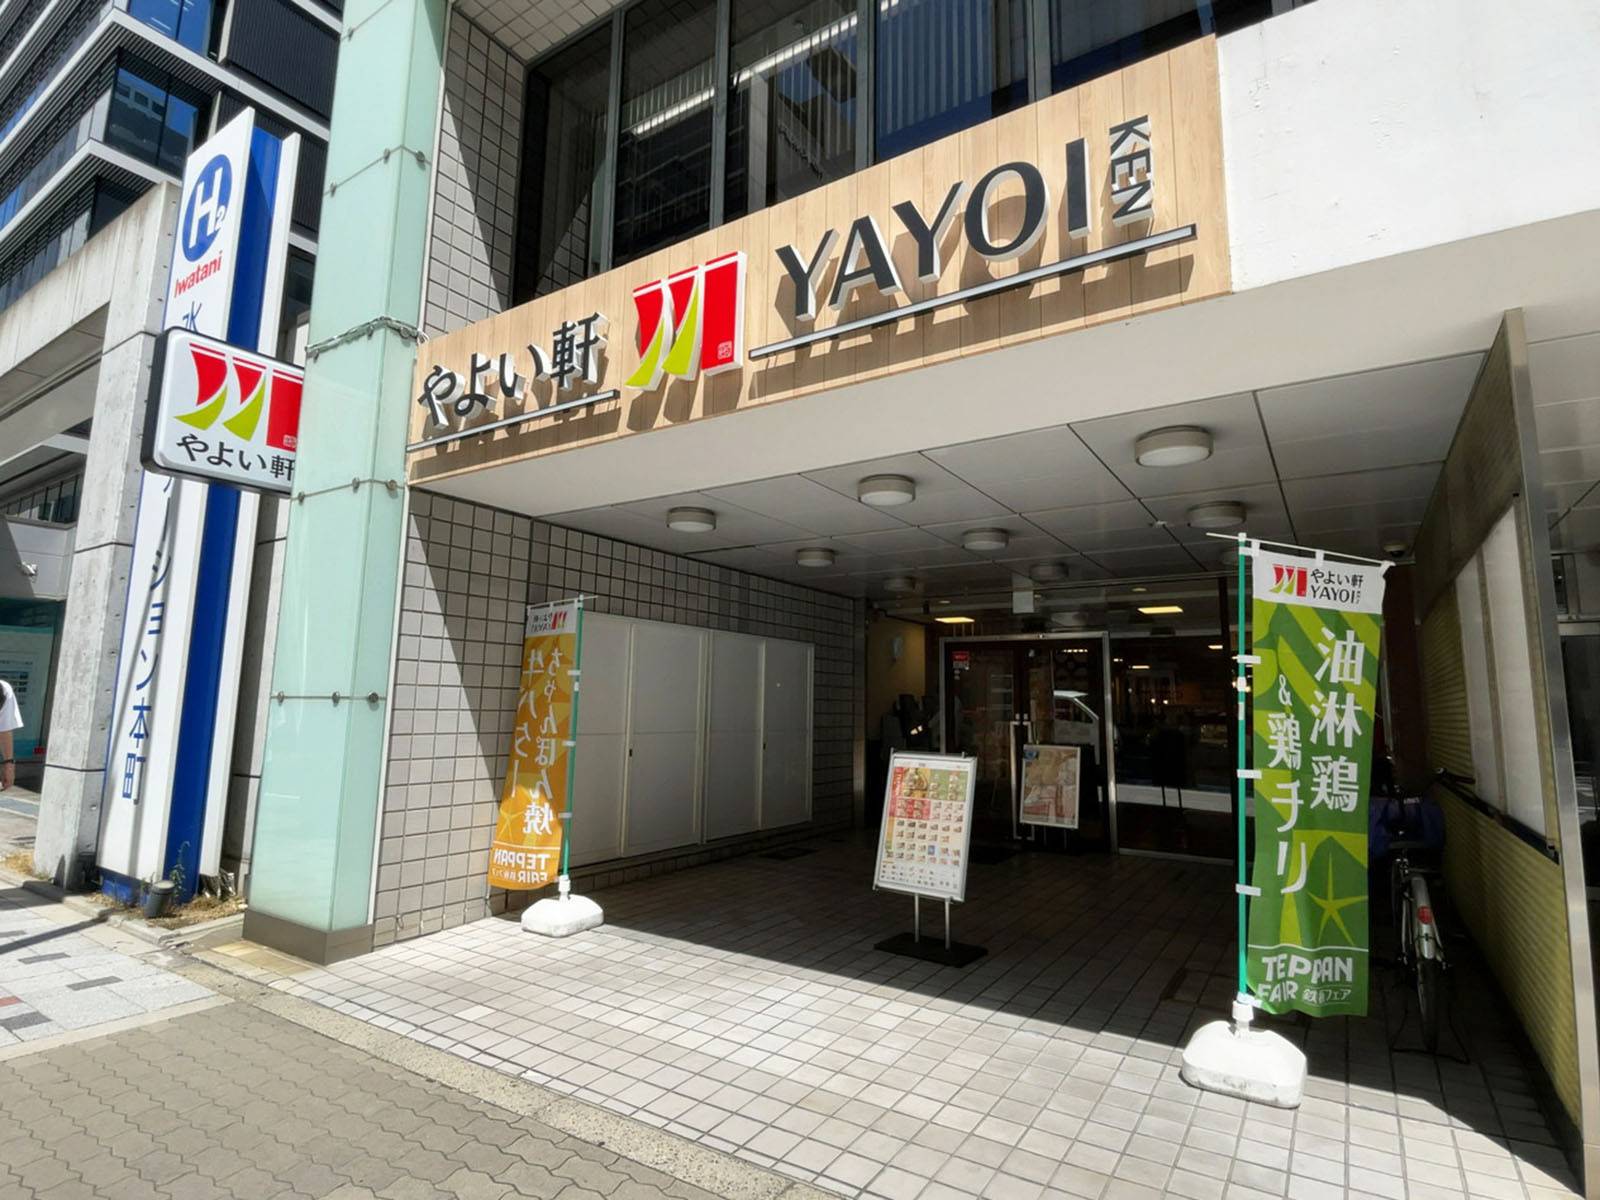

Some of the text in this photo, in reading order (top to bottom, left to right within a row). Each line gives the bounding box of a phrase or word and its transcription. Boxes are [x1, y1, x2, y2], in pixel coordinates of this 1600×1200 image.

[1109, 115, 1154, 227] KEN
[775, 136, 1092, 321] YAYOI
[174, 250, 223, 299] Iwatani
[417, 311, 607, 430] やよい軒
[176, 433, 296, 482] やよい軒
[1310, 568, 1364, 589] やよい軒
[1310, 585, 1356, 604] YAYOI
[122, 477, 173, 806] ーション本町
[1309, 626, 1365, 813] 油淋鶏
[1257, 980, 1299, 1003] FAIR
[1261, 953, 1353, 985] TEPPAN
